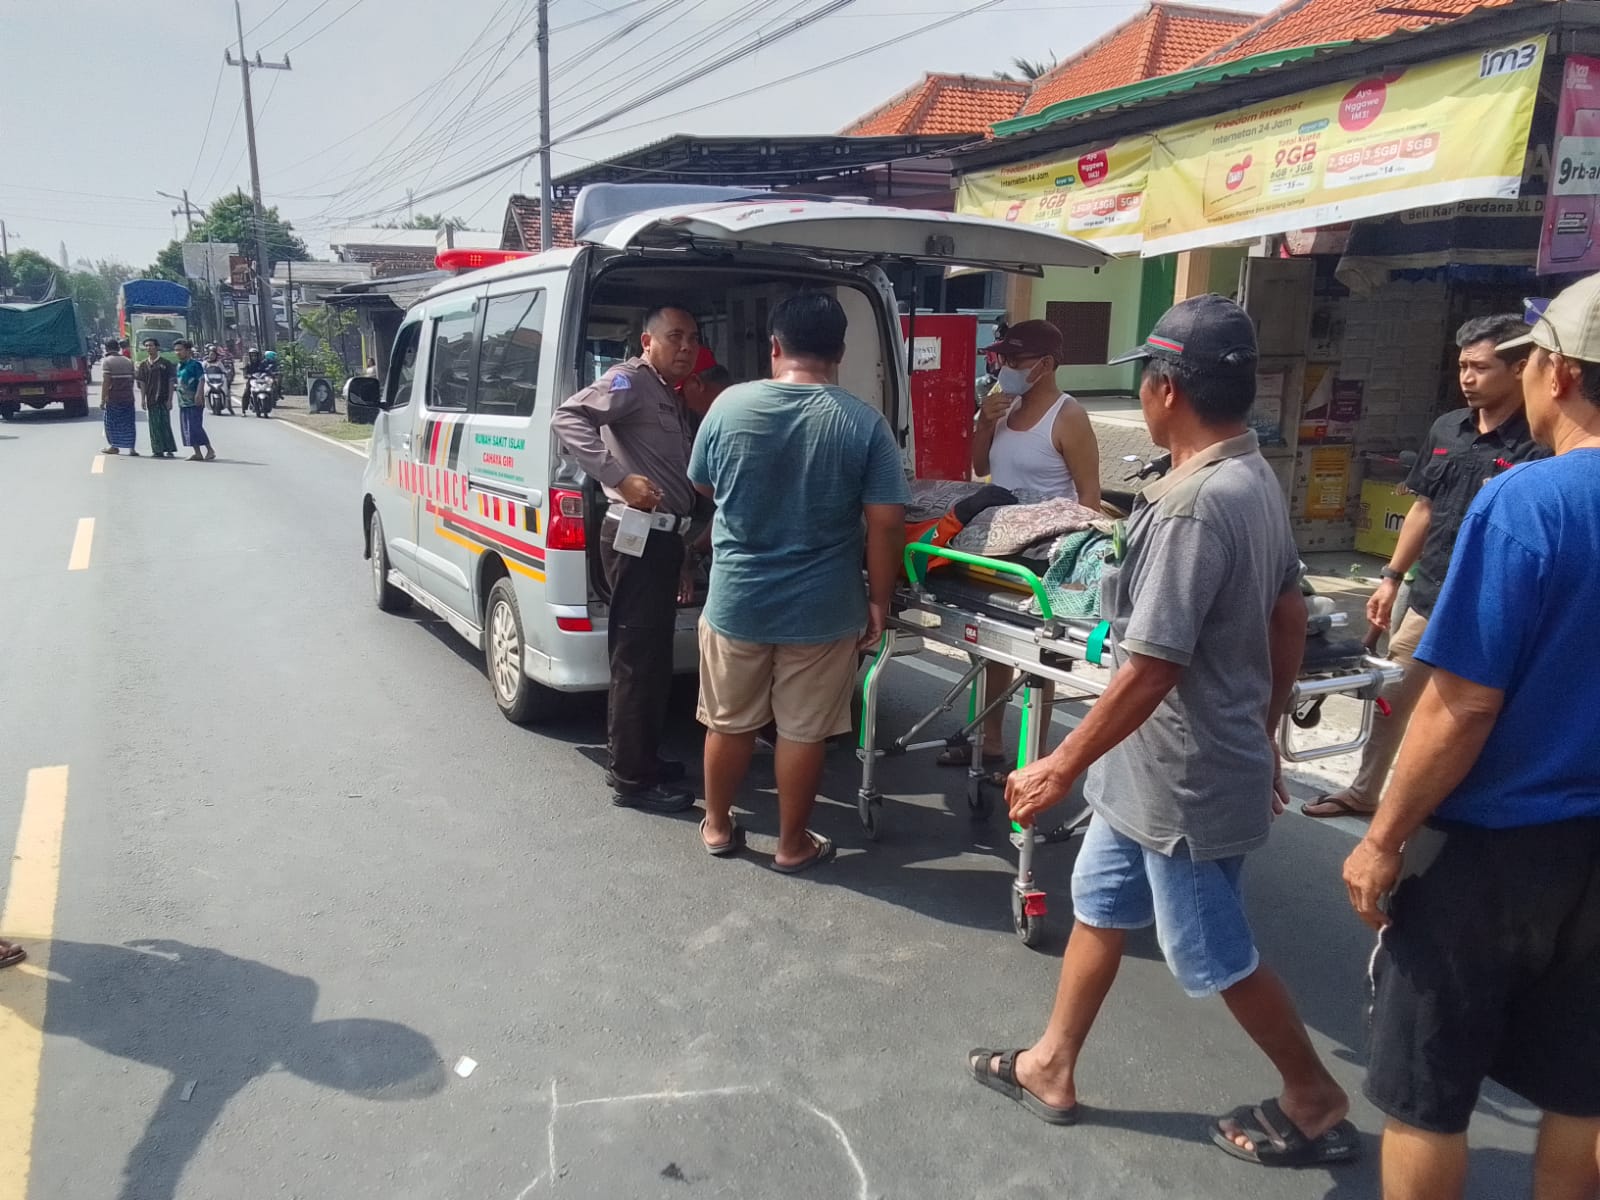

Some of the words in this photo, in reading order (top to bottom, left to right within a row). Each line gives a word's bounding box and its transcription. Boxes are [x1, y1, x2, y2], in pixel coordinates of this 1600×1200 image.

[1357, 88, 1372, 99] Ayo
[1345, 99, 1379, 112] Nggawe
[1214, 112, 1257, 130] Freedom
[1258, 101, 1304, 119] Internet
[1212, 128, 1257, 146] Internetan
[1258, 124, 1271, 134] 24
[1271, 118, 1293, 130] Jam
[1406, 137, 1433, 153] 5GB
[1274, 141, 1317, 168] 9GB
[1036, 172, 1049, 180] Jam
[1040, 191, 1067, 209] 9GB
[1408, 206, 1430, 220] Beli
[1457, 201, 1514, 214] Perdana
[1515, 201, 1531, 213] XL
[475, 433, 492, 445] RUMAH
[492, 435, 508, 448] SAKIT
[508, 437, 526, 450] ISLAM
[482, 452, 502, 465] CAHAYA
[502, 455, 514, 468] GIRI
[399, 459, 468, 511] AMBULANCE
